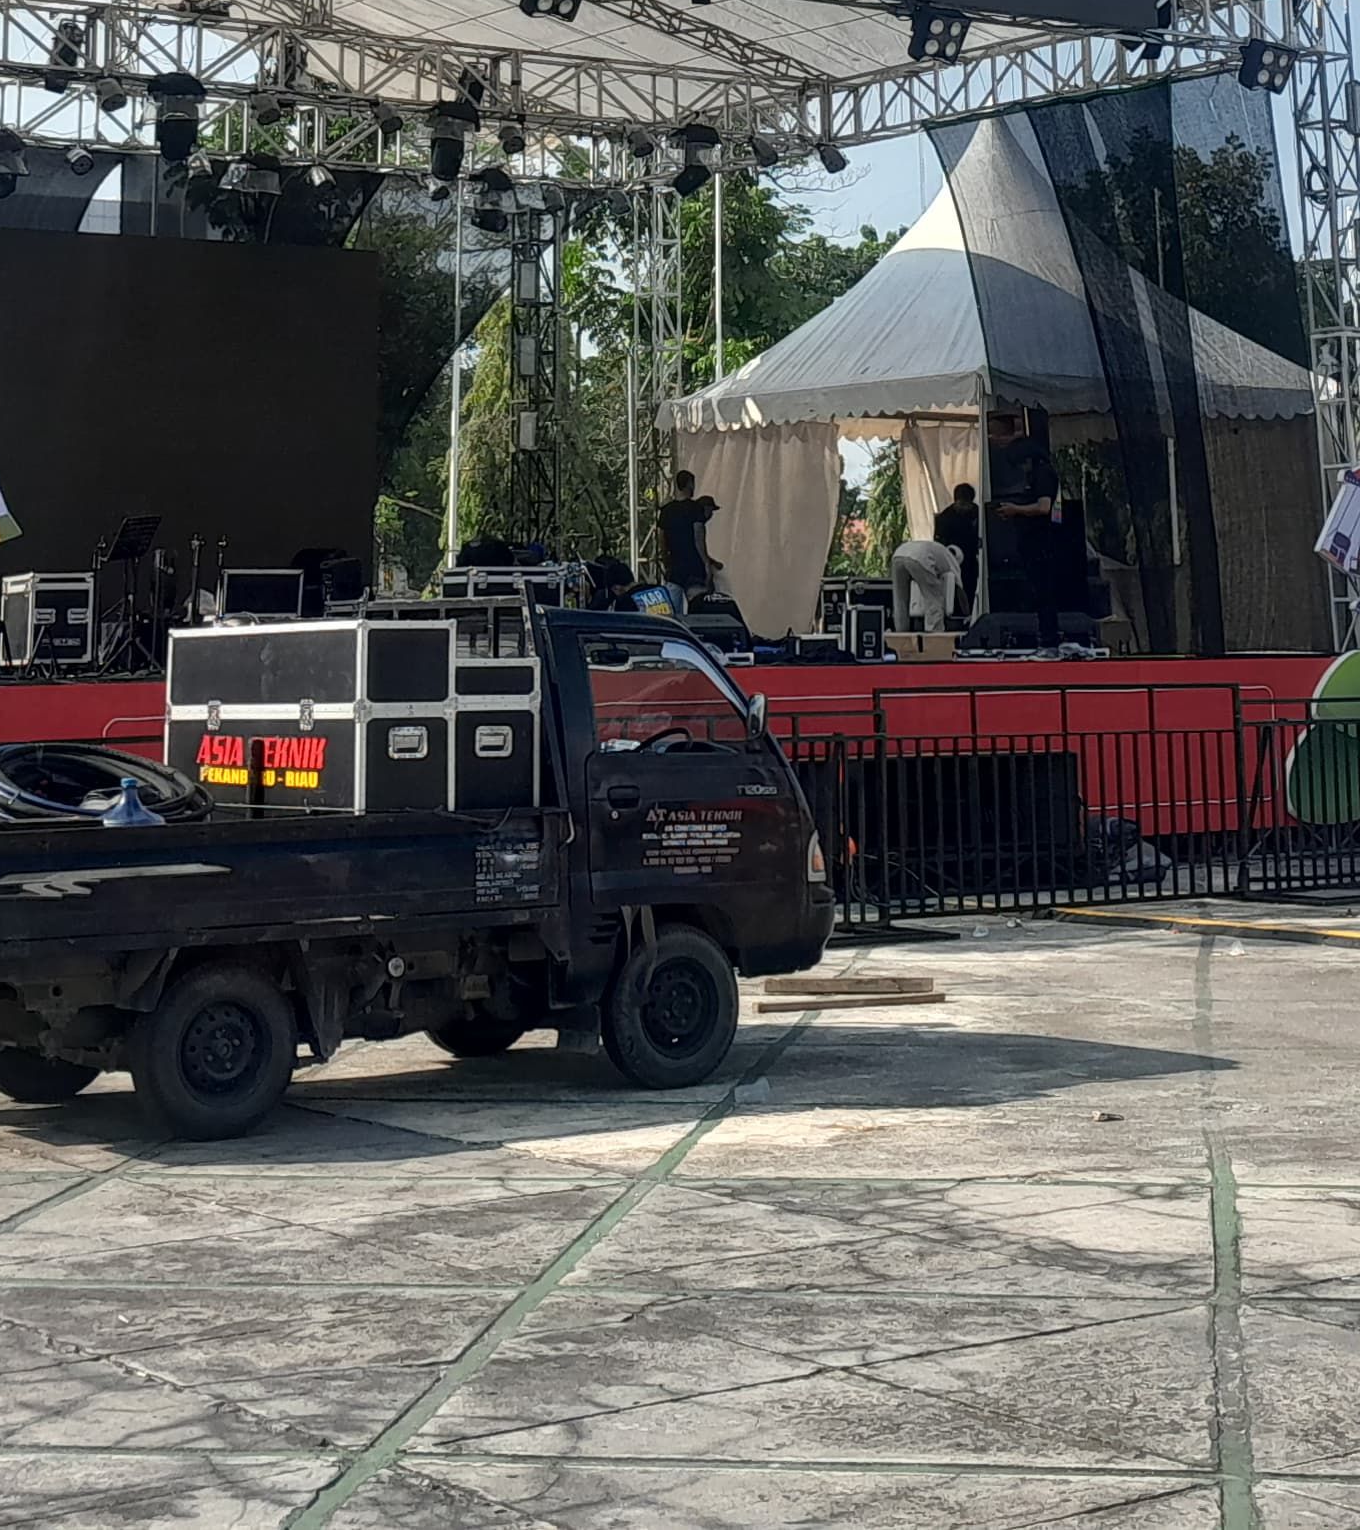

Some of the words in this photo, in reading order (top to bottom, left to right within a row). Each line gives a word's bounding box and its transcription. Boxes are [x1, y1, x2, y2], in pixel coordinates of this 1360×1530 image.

[196, 735, 244, 767] ASIA
[252, 737, 327, 769] EKNIK
[200, 766, 276, 787] PEKANBU
[668, 810, 696, 822] ASIA
